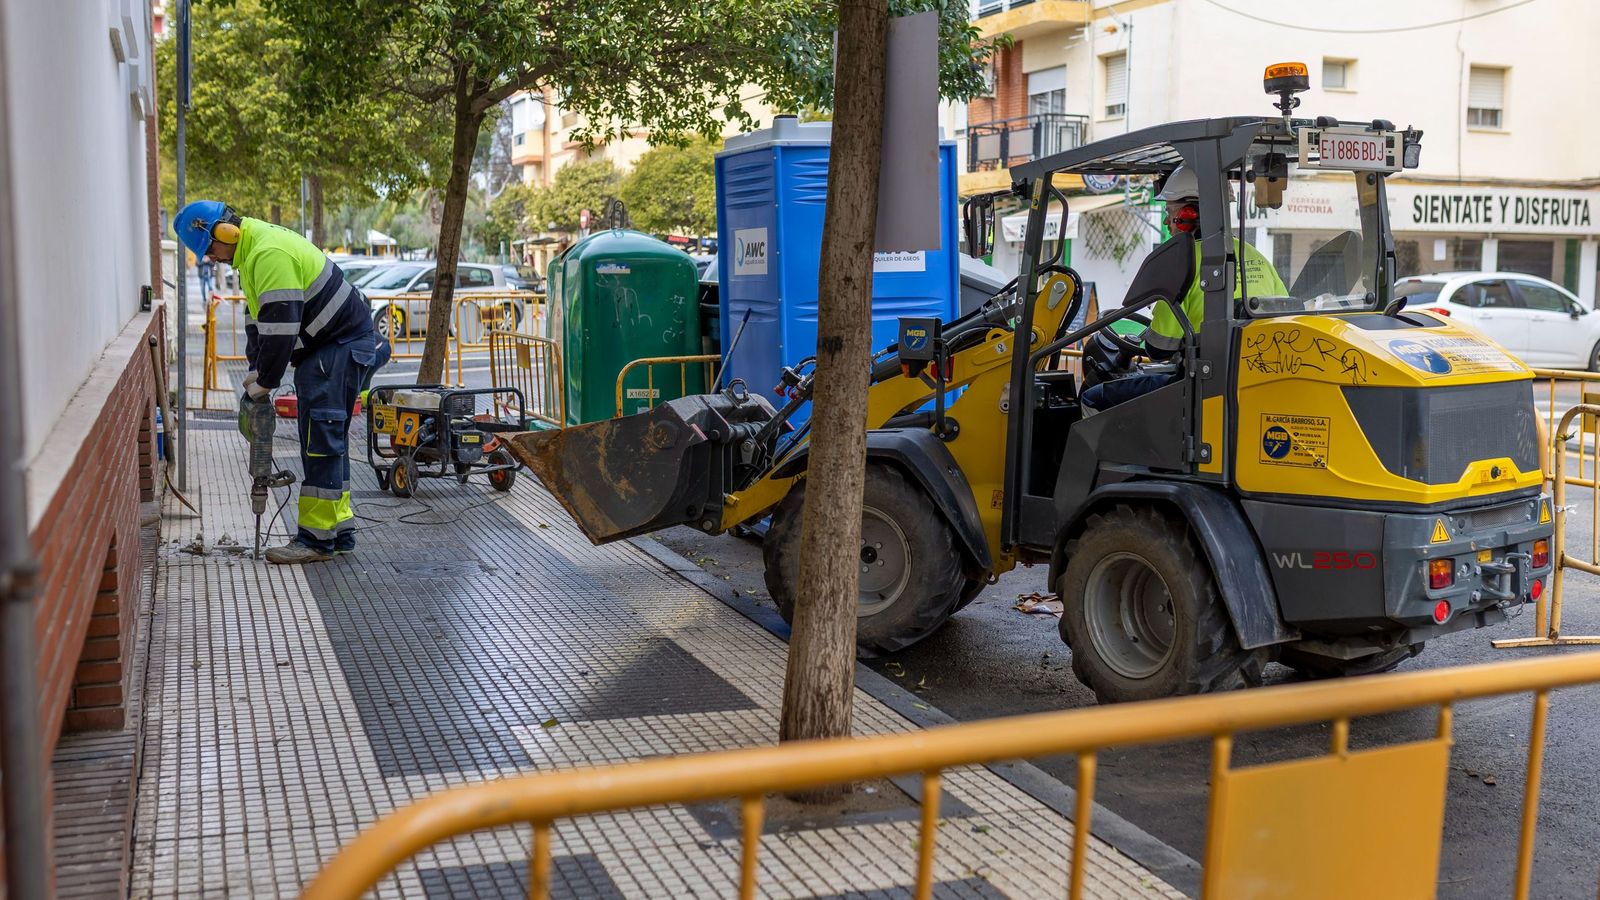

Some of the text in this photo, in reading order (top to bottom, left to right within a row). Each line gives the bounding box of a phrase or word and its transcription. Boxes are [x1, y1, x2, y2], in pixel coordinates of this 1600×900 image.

[1287, 204, 1333, 214] VICTORIA
[1412, 194, 1493, 224] SIENTATE
[1499, 195, 1510, 224] Y
[1514, 197, 1591, 226] DISFRUTA
[745, 241, 766, 258] AWC
[906, 329, 926, 337] MGB
[1267, 431, 1288, 441] MGB
[1272, 552, 1377, 570] WL250
